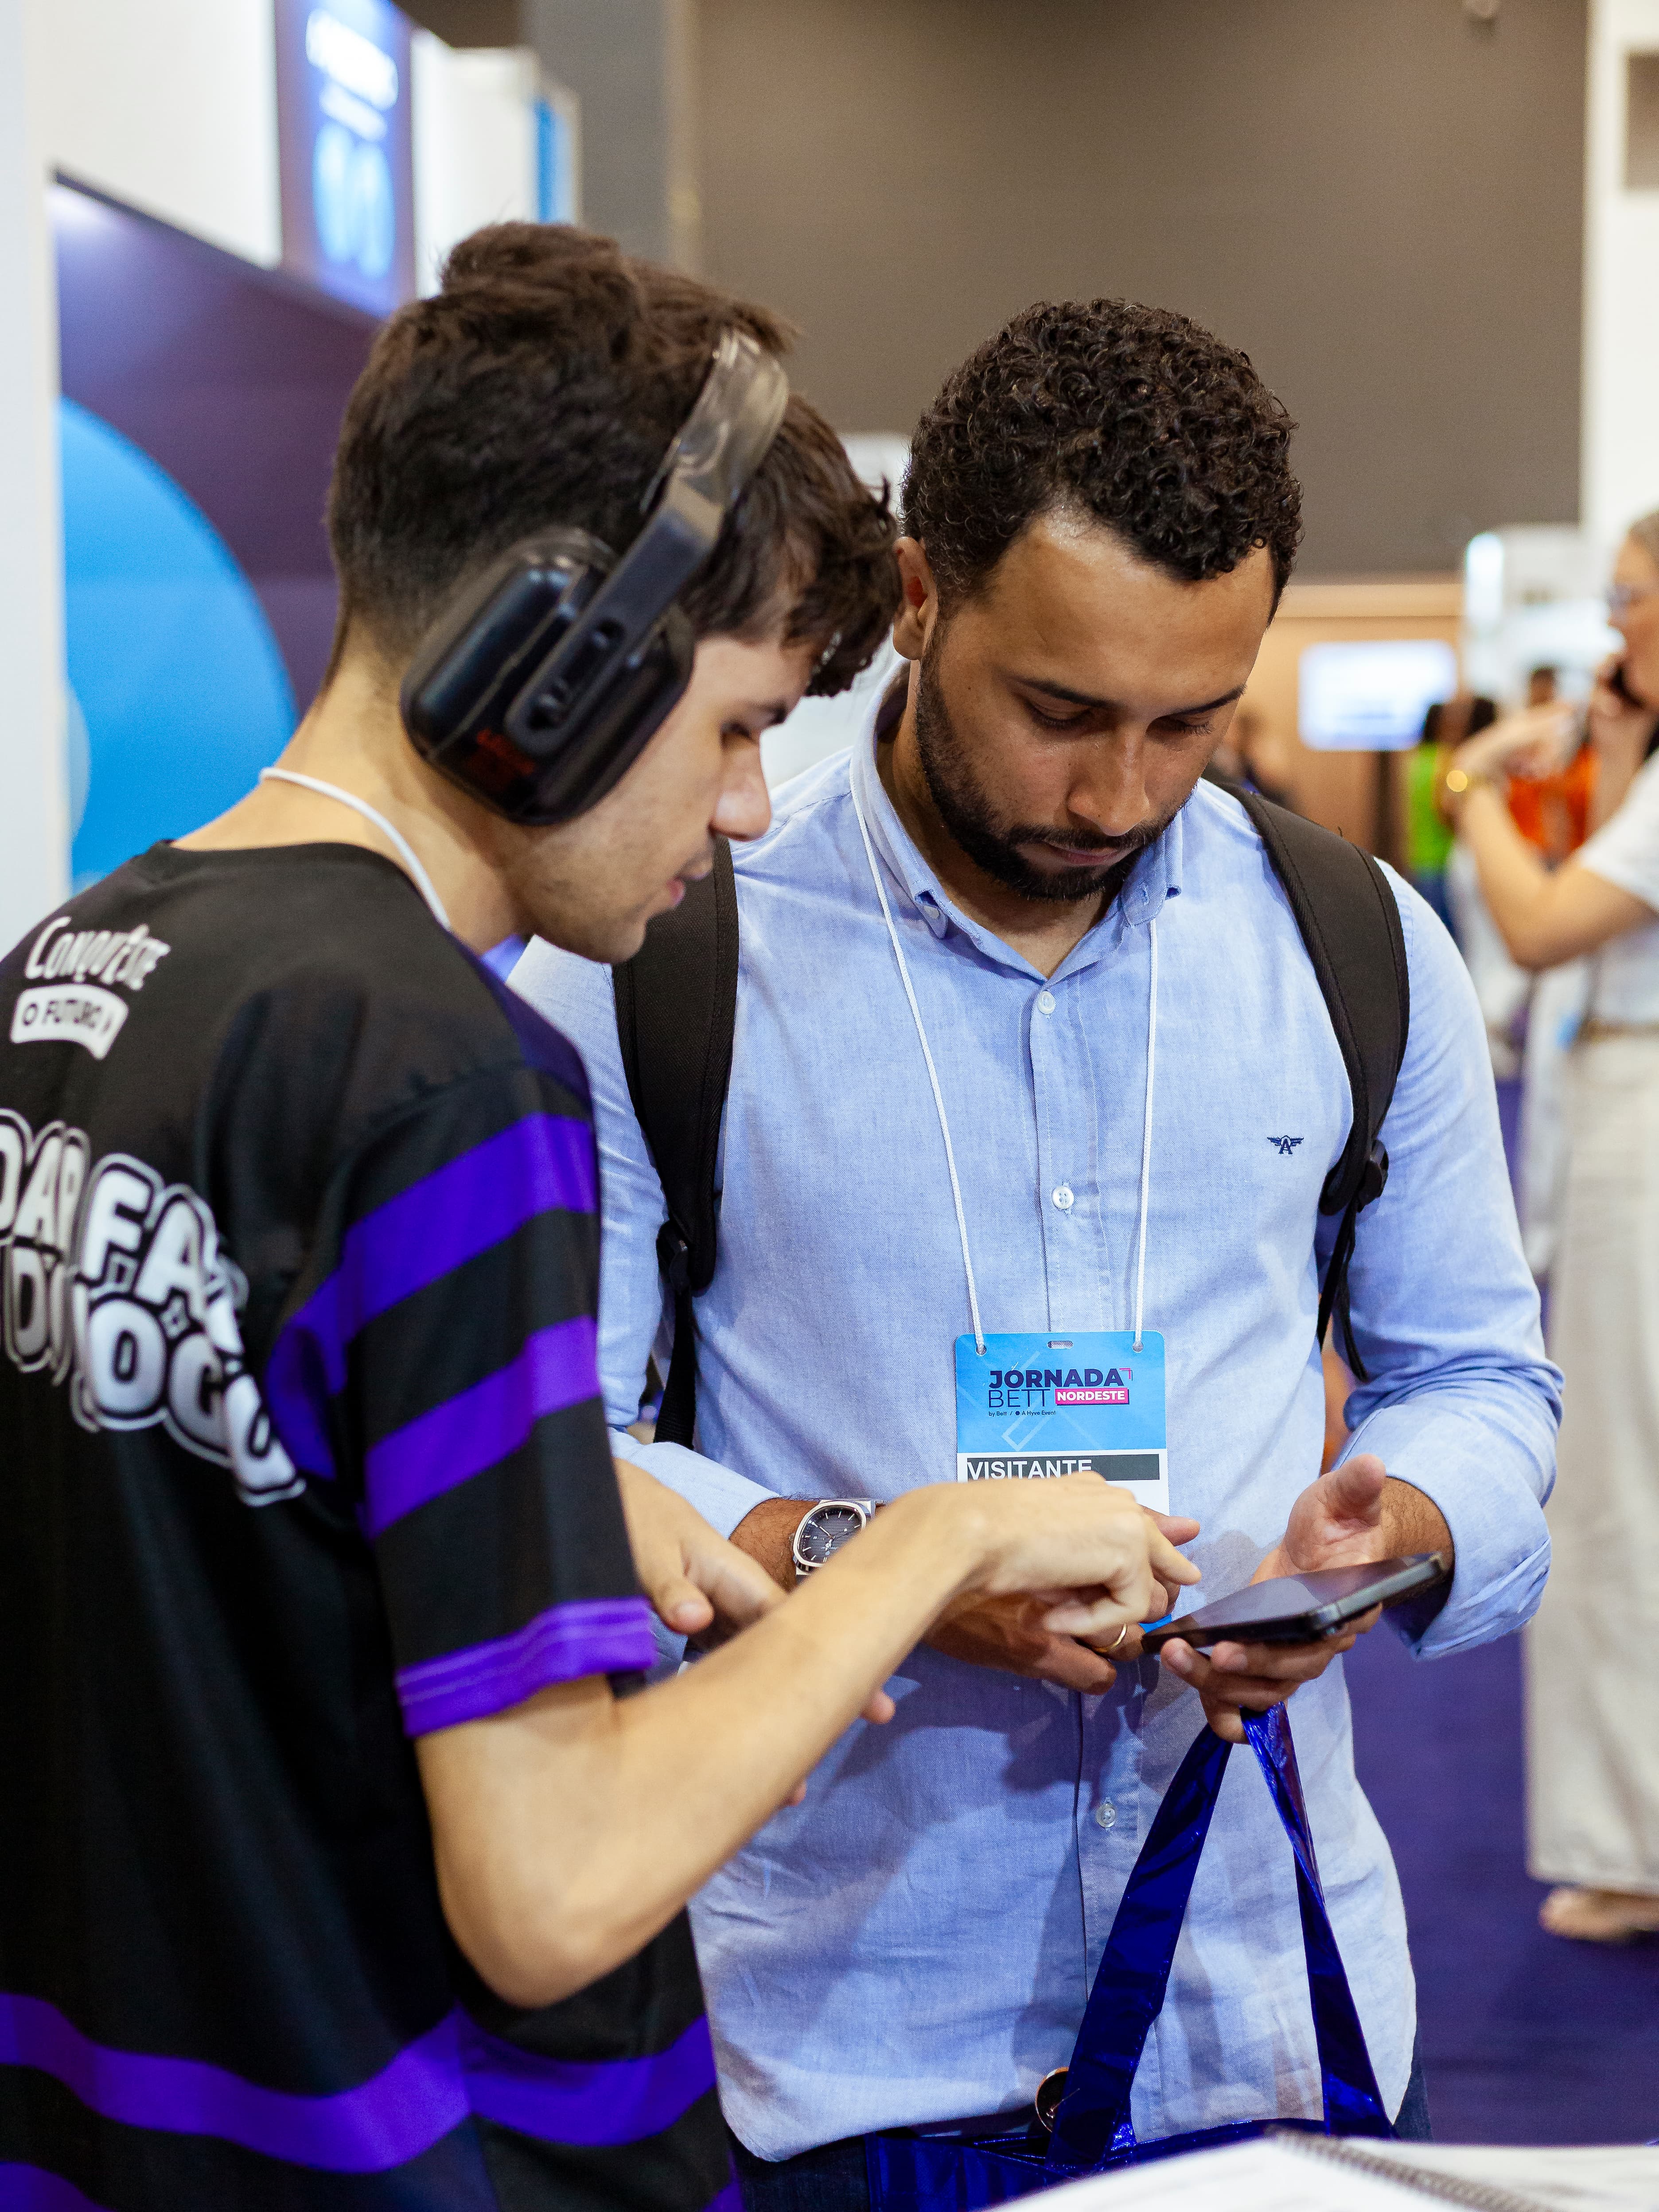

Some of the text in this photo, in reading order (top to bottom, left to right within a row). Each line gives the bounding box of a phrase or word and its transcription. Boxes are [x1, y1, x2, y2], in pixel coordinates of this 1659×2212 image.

[79, 1157, 246, 1354] FA
[989, 1368, 1124, 1389] JORNADA
[989, 1389, 1125, 1408] BETT NORDESTE
